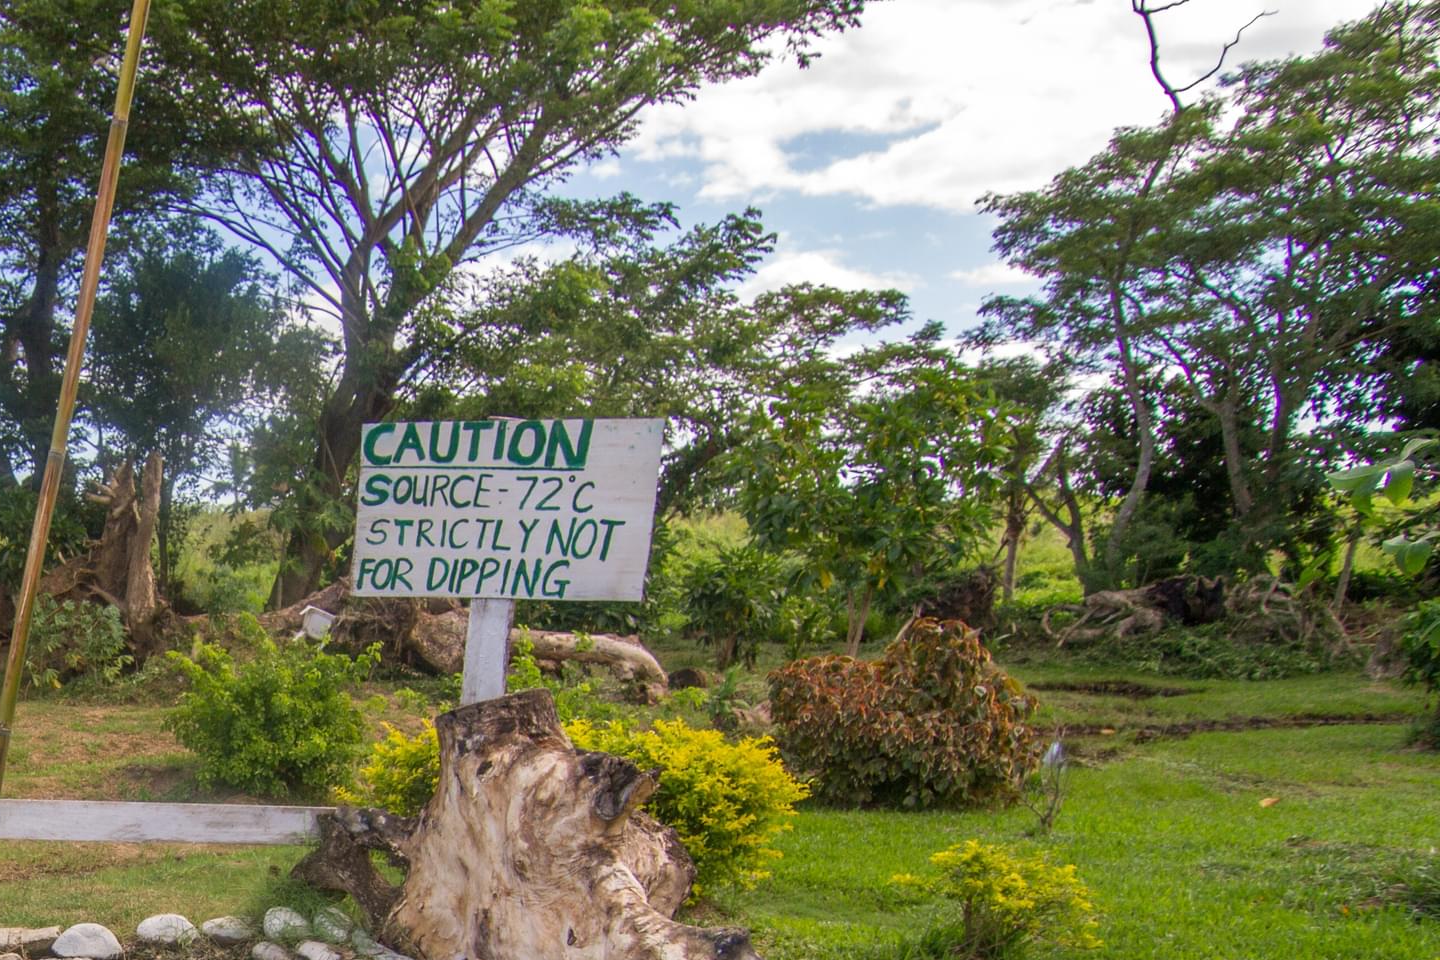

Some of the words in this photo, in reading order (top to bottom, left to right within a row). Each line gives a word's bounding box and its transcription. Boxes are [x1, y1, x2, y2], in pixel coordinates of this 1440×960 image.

[363, 419, 594, 467] CAUTION
[365, 518, 540, 553] STRICTLY
[545, 517, 626, 561] NOT
[356, 557, 413, 591] FOR
[426, 557, 571, 599] DIPPING
